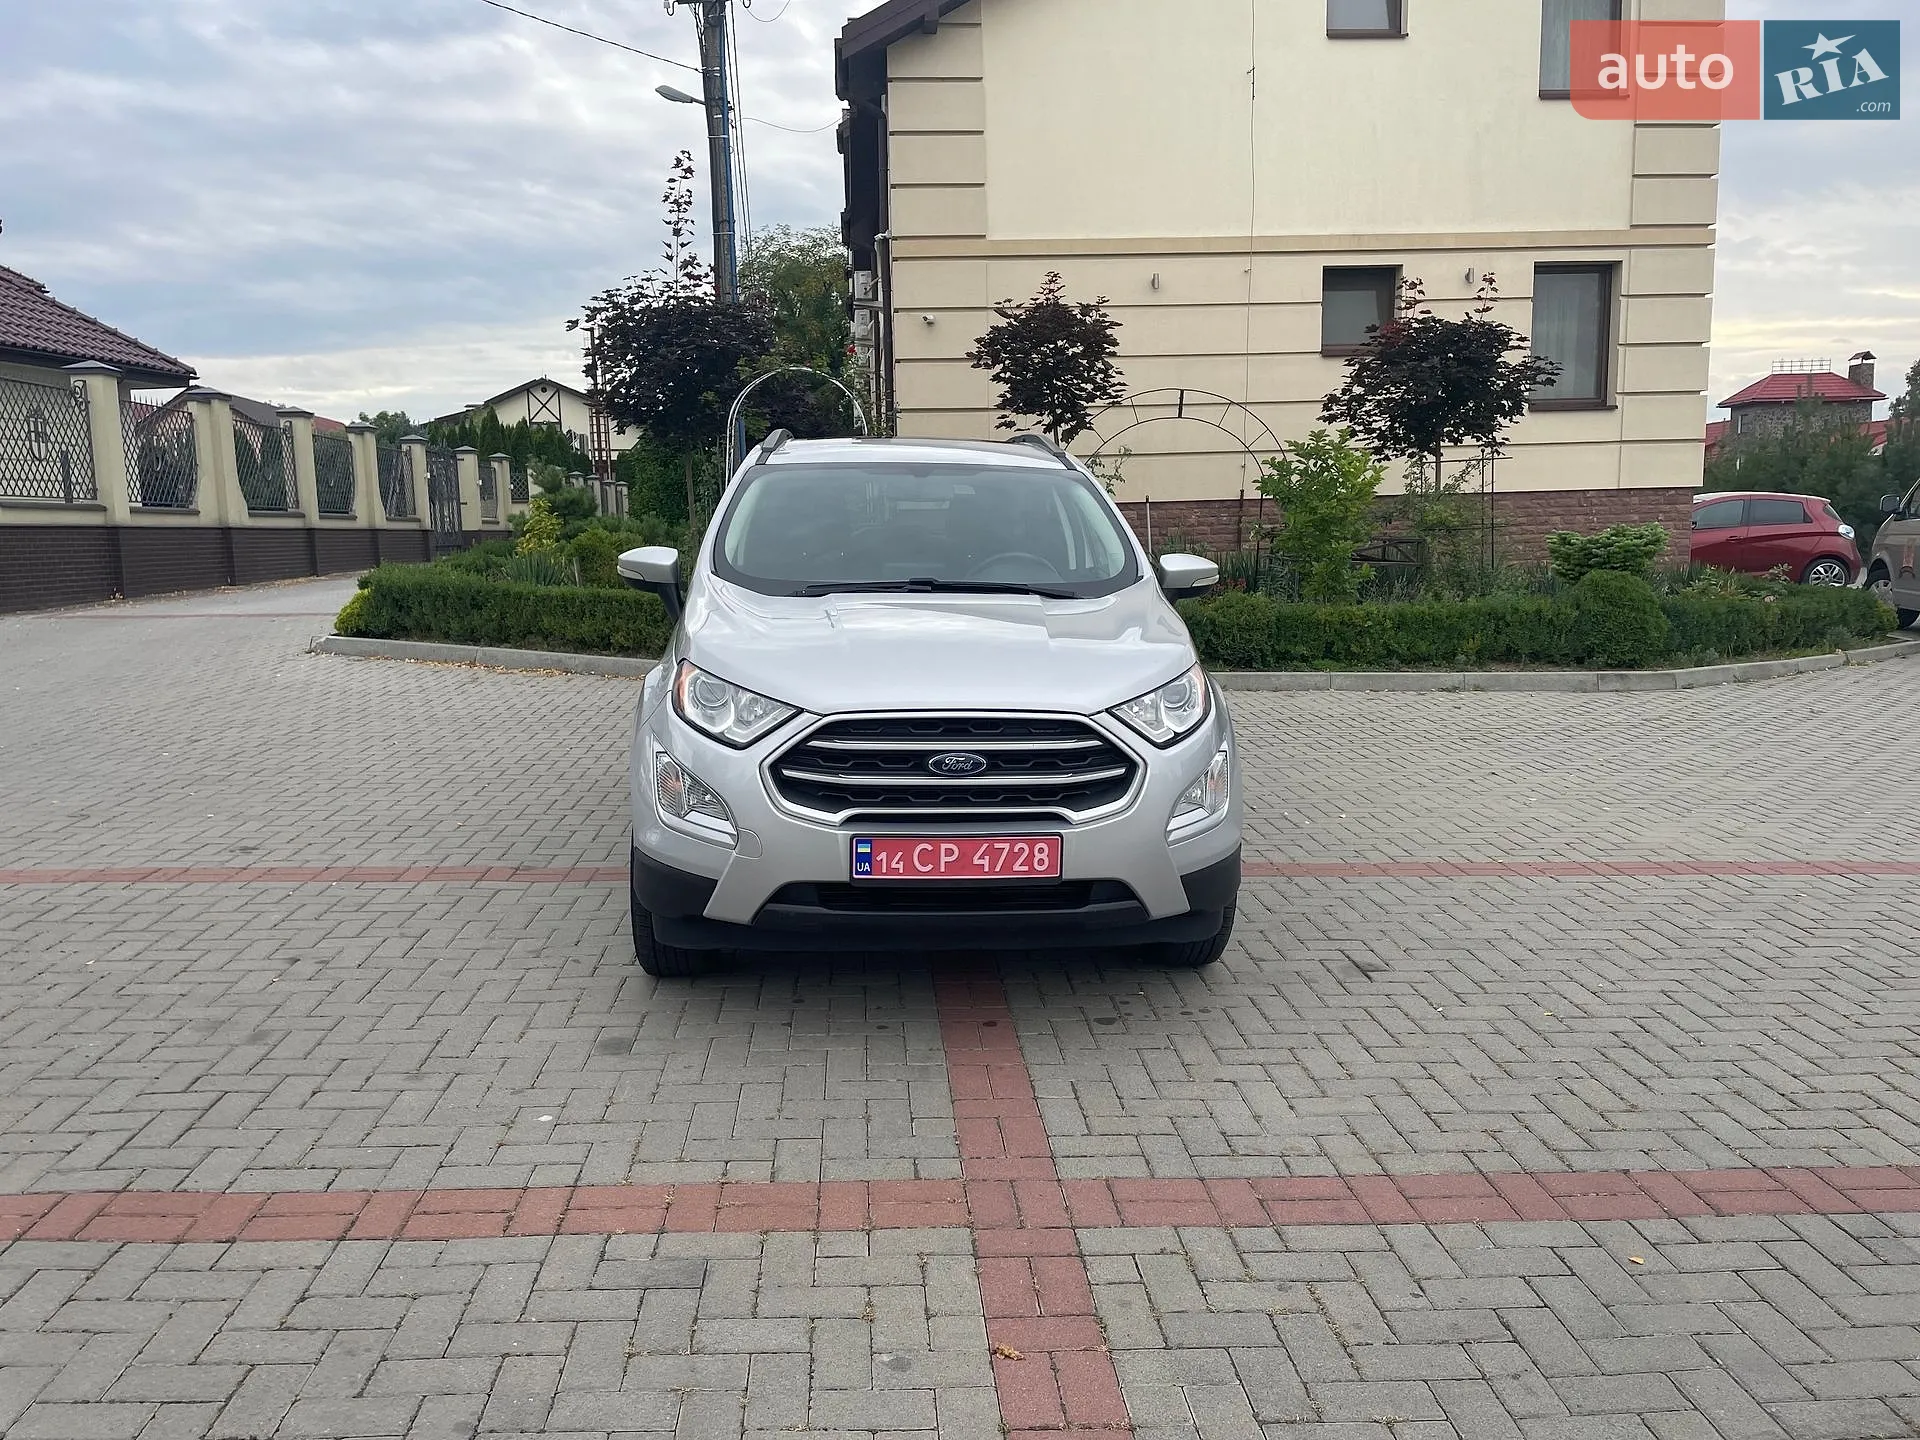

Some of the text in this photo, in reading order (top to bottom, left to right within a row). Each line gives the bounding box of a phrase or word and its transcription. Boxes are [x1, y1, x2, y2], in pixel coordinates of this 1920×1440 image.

[941, 756, 973, 770] Ford
[876, 842, 1050, 874] 14 CP 4728
[857, 862, 871, 872] UA
